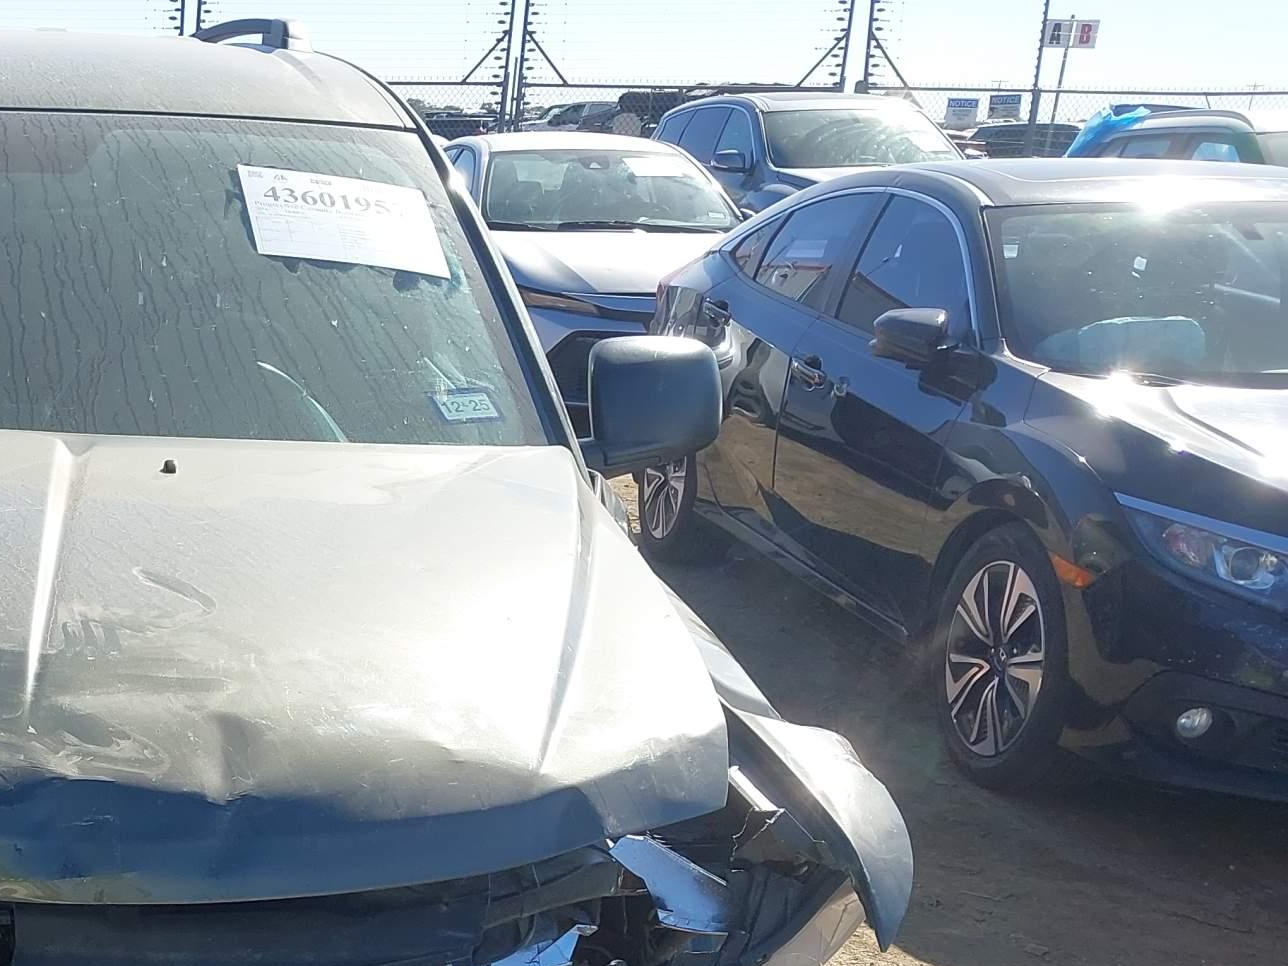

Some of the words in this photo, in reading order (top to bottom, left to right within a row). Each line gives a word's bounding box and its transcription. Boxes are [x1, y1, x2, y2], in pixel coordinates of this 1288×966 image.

[1048, 22, 1062, 45] A
[1079, 23, 1093, 45] B
[989, 96, 1020, 104] NOTICE
